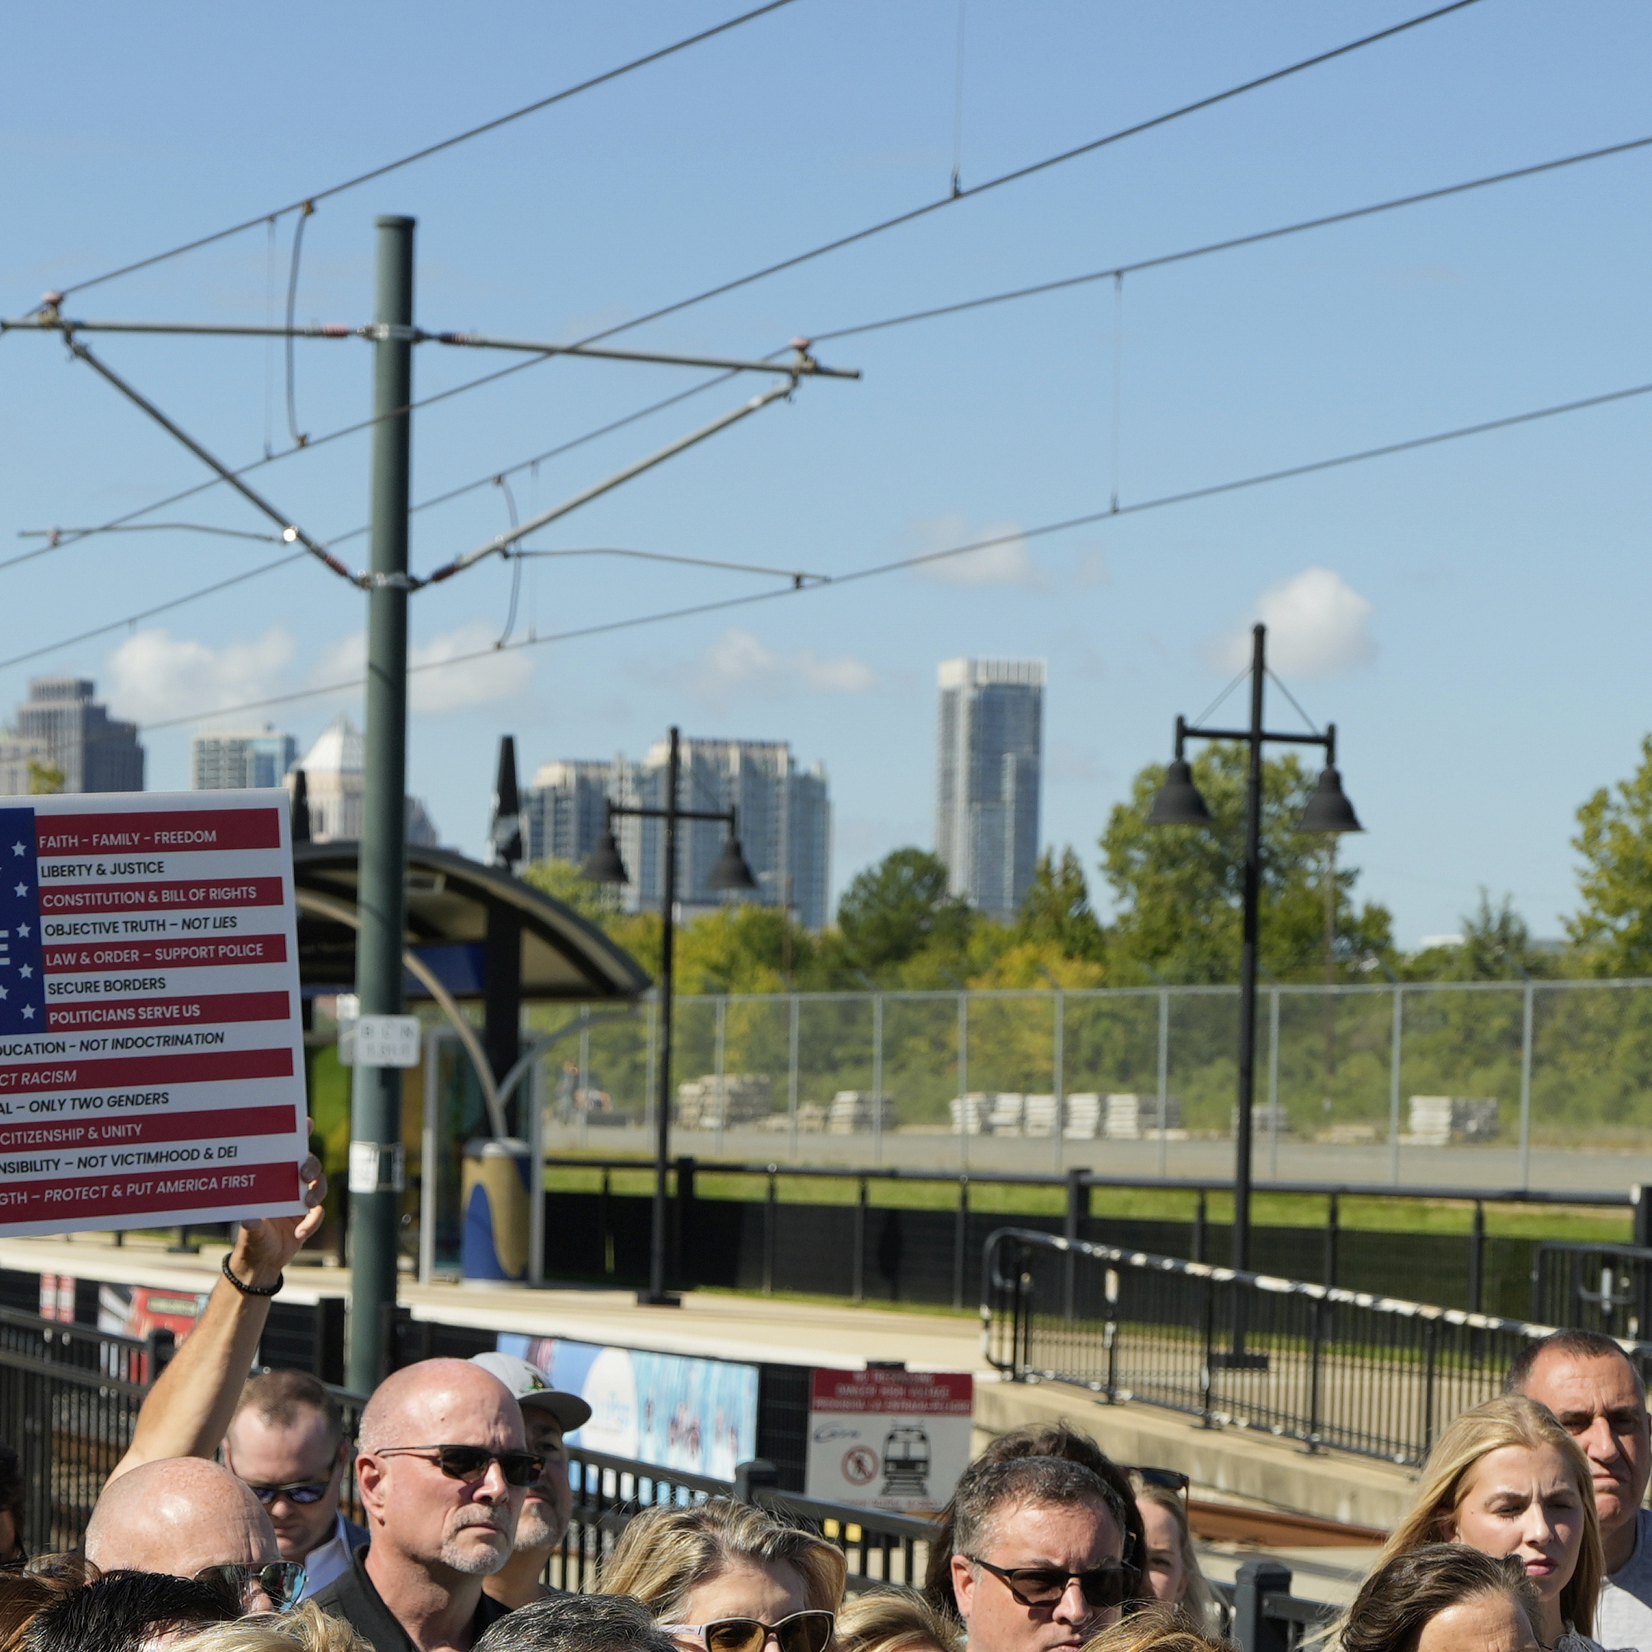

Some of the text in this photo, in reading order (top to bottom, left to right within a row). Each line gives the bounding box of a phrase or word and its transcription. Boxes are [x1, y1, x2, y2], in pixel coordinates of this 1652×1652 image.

[39, 834, 79, 849] FAITH
[92, 832, 141, 847] FAMILY
[154, 829, 217, 844] FREEDOM
[40, 860, 165, 878] LIBERTY & JUSTICE
[42, 886, 257, 908] CONSTITUTION & BILL OF RIGHTS
[44, 921, 120, 937] OBJECTIVE
[121, 918, 166, 933] TRUTH
[181, 916, 211, 931] NOT
[212, 915, 238, 929] LIES
[45, 952, 77, 967] LAW
[79, 951, 91, 965] &
[93, 949, 140, 964] ORDER
[154, 945, 216, 961] SUPPORT
[218, 943, 264, 958] POLICE
[47, 976, 166, 996] SECURE BORDERS
[49, 1003, 201, 1025] POLITICIANS SERVE US
[79, 1038, 109, 1052] NOT
[111, 1031, 225, 1050] INDOCTRINATION
[20, 1069, 77, 1085] RACISM
[28, 1098, 67, 1113] ONLY
[70, 1096, 104, 1111] TWO
[106, 1091, 169, 1108] GENDERS
[0, 1127, 85, 1146] CITIZENSHIP
[87, 1126, 99, 1140] &
[101, 1123, 143, 1139] UNITY
[77, 1154, 108, 1170] NOT
[110, 1148, 201, 1167] VICTIMHOOD
[203, 1147, 214, 1160] &
[217, 1145, 238, 1159] DEI
[44, 1185, 109, 1203] PROTECT
[111, 1184, 123, 1198] &
[126, 1181, 154, 1197] PUT
[155, 1177, 219, 1194] AMERICA
[221, 1173, 257, 1189] FIRST
